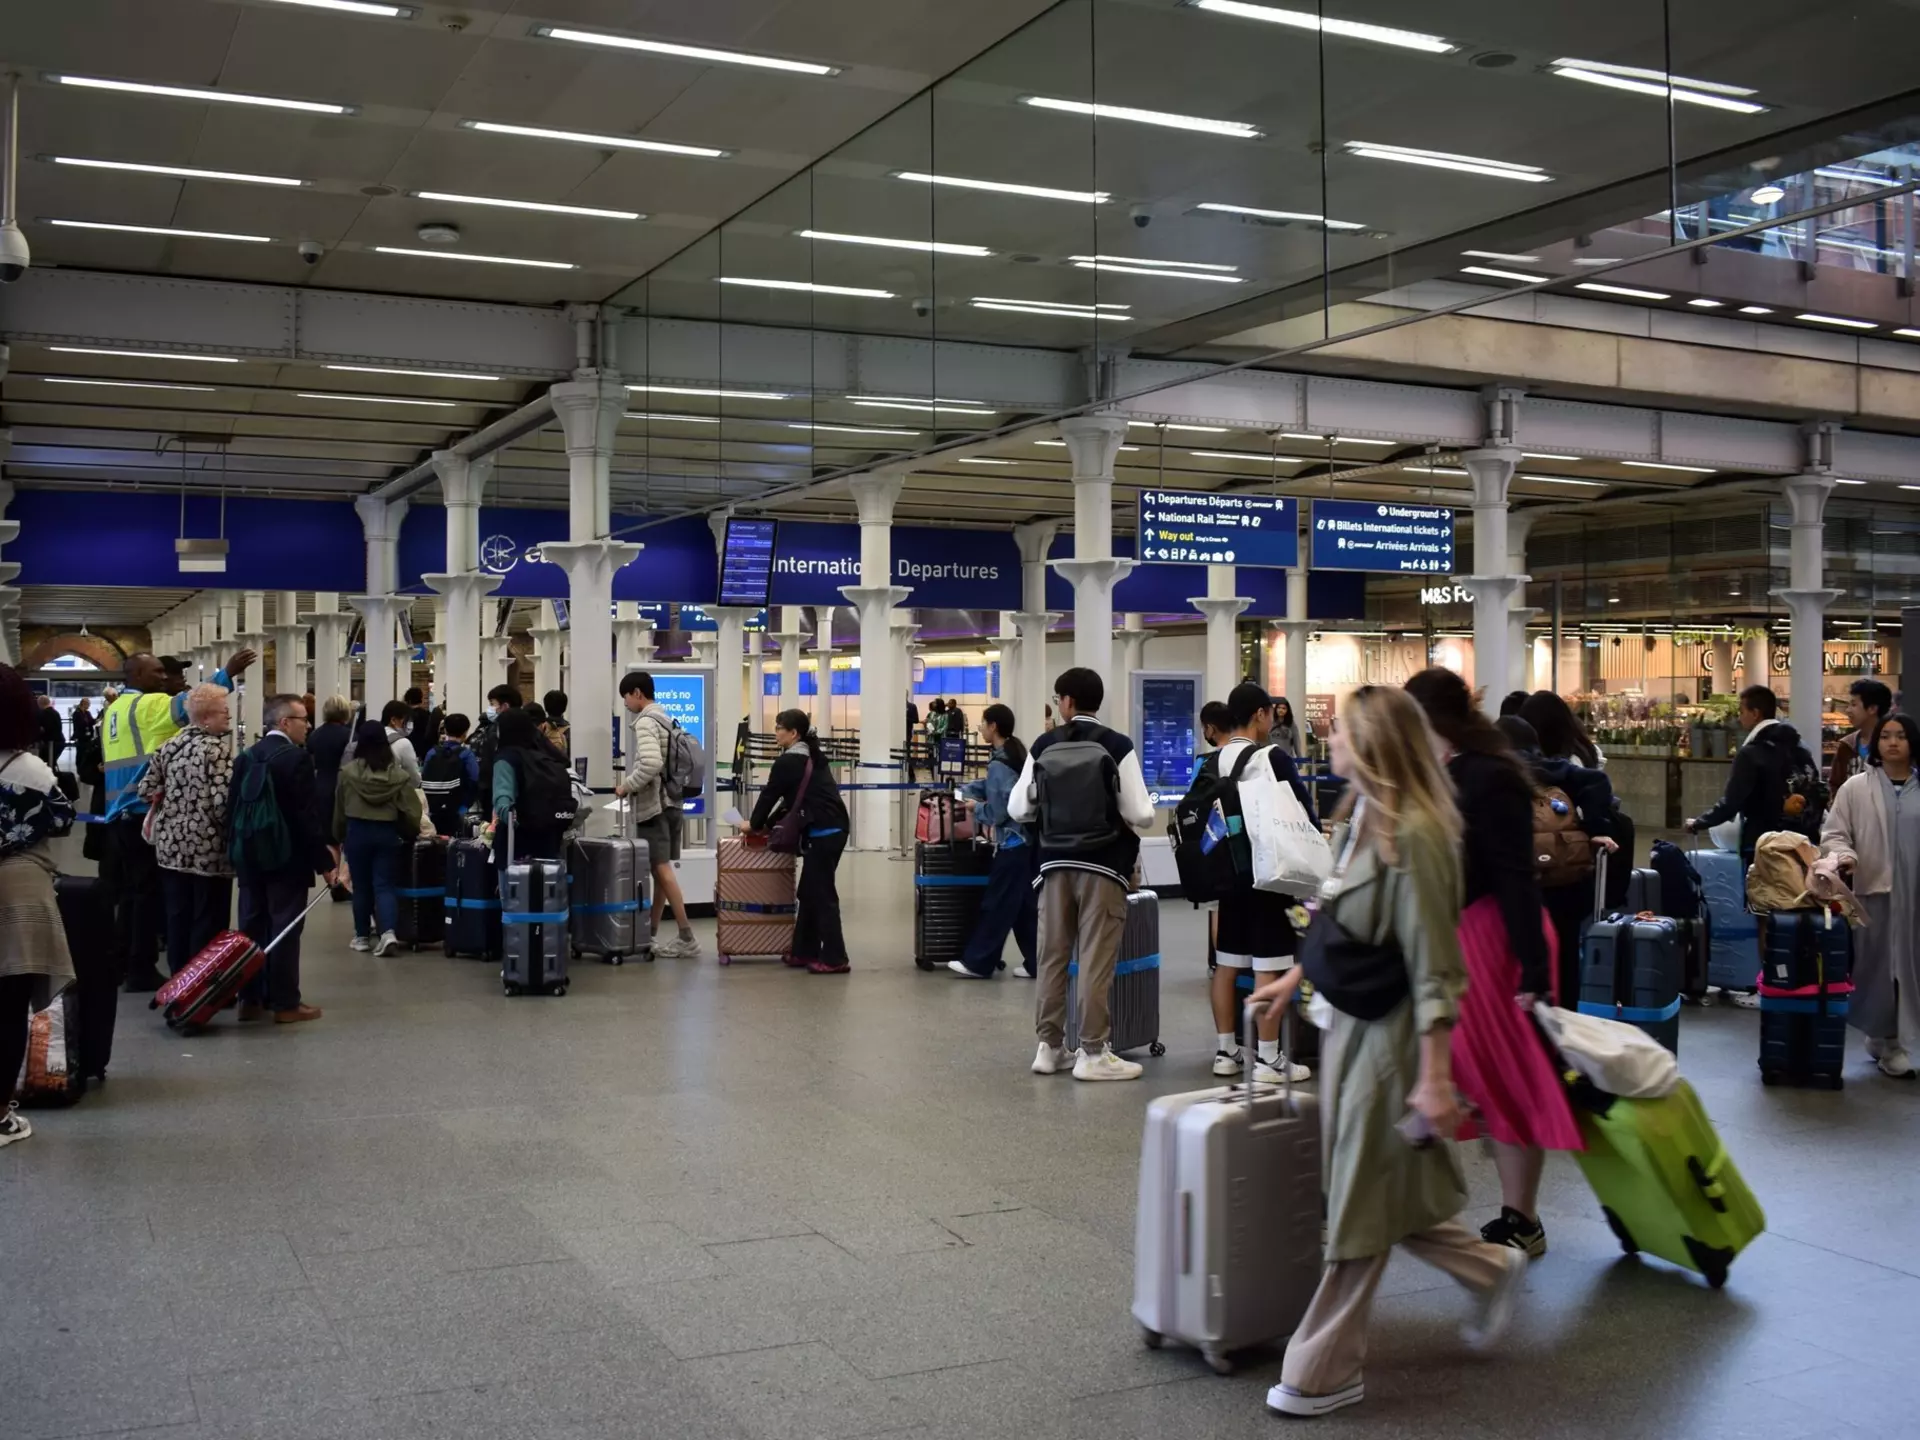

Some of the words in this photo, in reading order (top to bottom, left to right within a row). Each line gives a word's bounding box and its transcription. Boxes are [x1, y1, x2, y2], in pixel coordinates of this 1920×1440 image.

[1158, 493, 1207, 506] Departures
[1209, 496, 1243, 508] Départs
[1158, 512, 1195, 523] National
[1197, 513, 1214, 524] Rail
[1389, 507, 1439, 519] Underground
[1337, 521, 1362, 531] Billets
[1364, 522, 1412, 534] International
[1414, 525, 1439, 535] tickets
[1159, 530, 1178, 542] Way
[1179, 532, 1194, 541] out
[1376, 541, 1408, 551] Arrivées
[1409, 542, 1439, 552] Arrivals
[773, 556, 892, 575] Internatio
[898, 559, 999, 581] Departures
[1421, 586, 1451, 604] M&S
[679, 691, 691, 699] no
[685, 703, 696, 711] so
